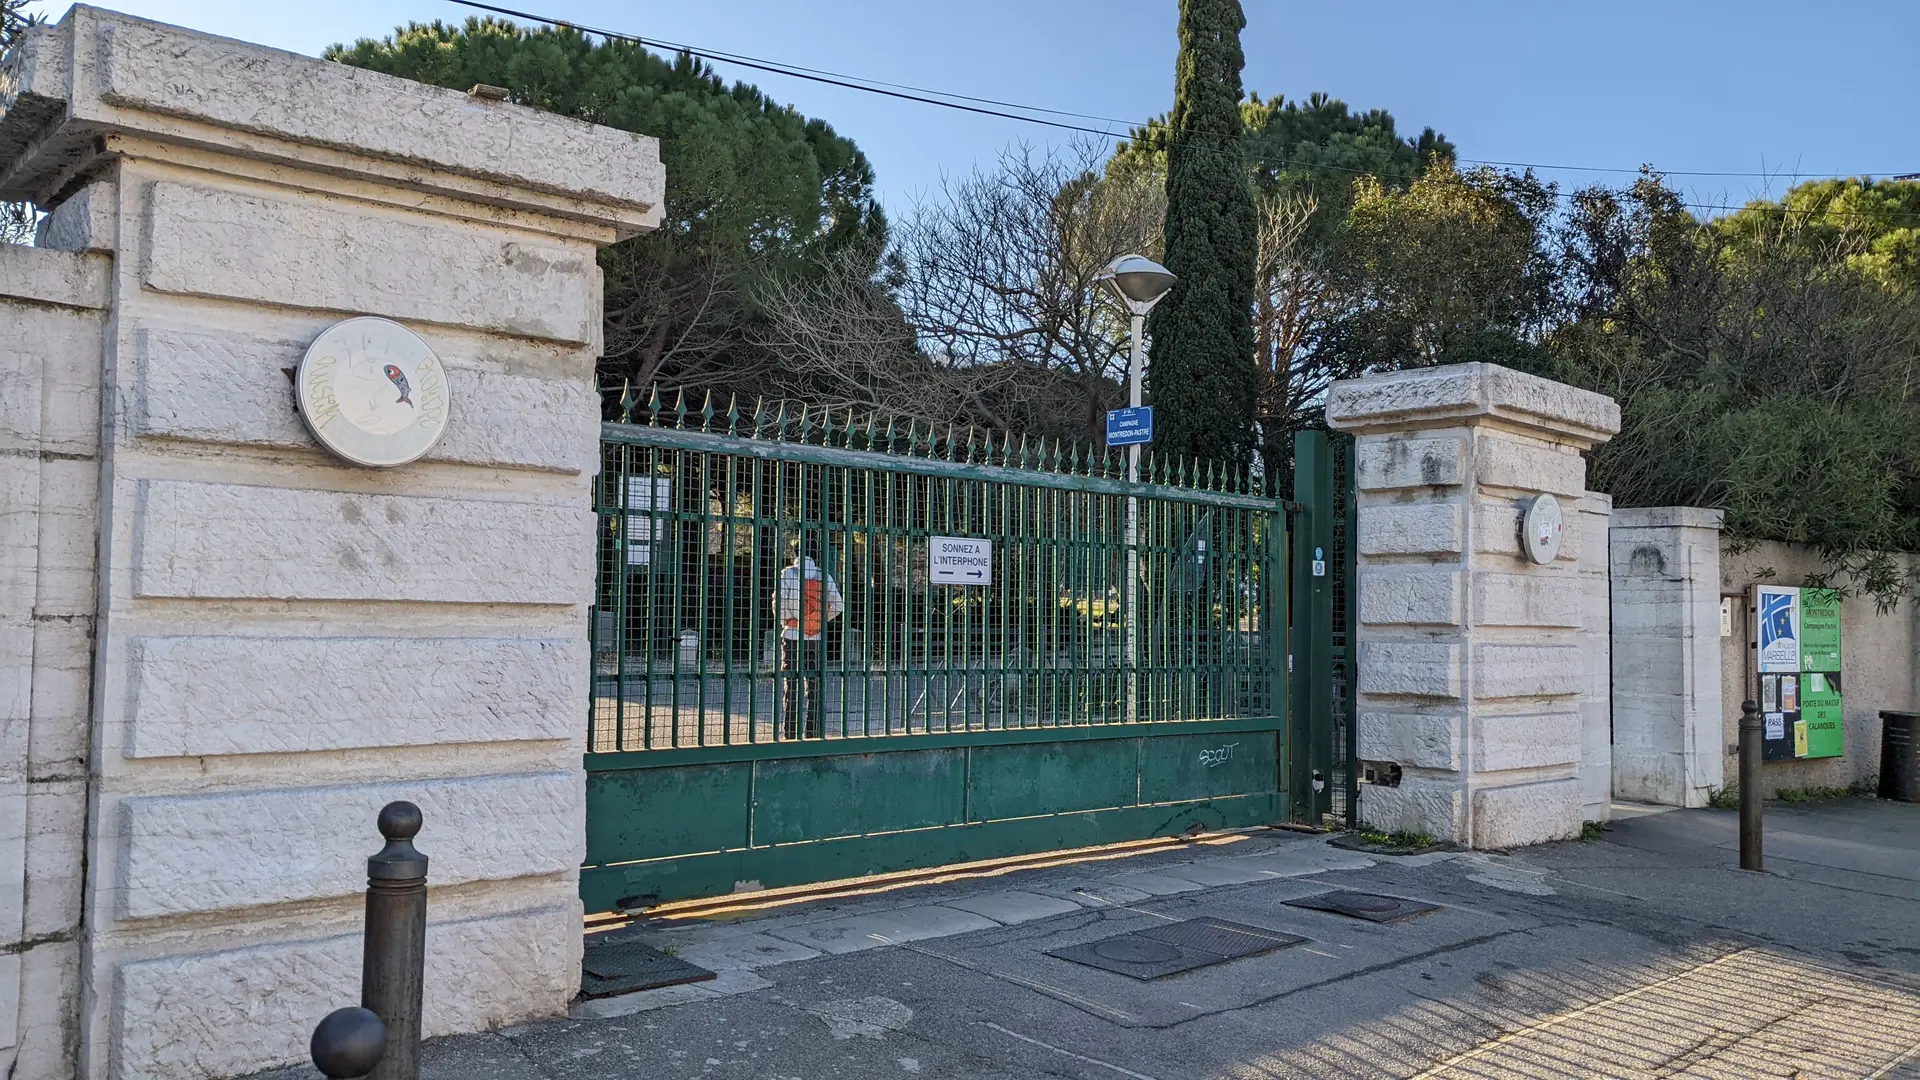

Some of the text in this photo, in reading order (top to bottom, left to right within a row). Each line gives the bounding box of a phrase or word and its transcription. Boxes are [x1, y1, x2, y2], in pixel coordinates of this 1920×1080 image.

[942, 543, 980, 554] SONNEZ A
[933, 555, 988, 567] L'INTERPHONE
[1804, 622, 1824, 630] Campagne
[1762, 650, 1796, 661] MARSEILLE
[1802, 699, 1840, 707] PORTE DU MASSIF
[1768, 718, 1782, 726] PASS
[1809, 722, 1835, 730] CALANQUES
